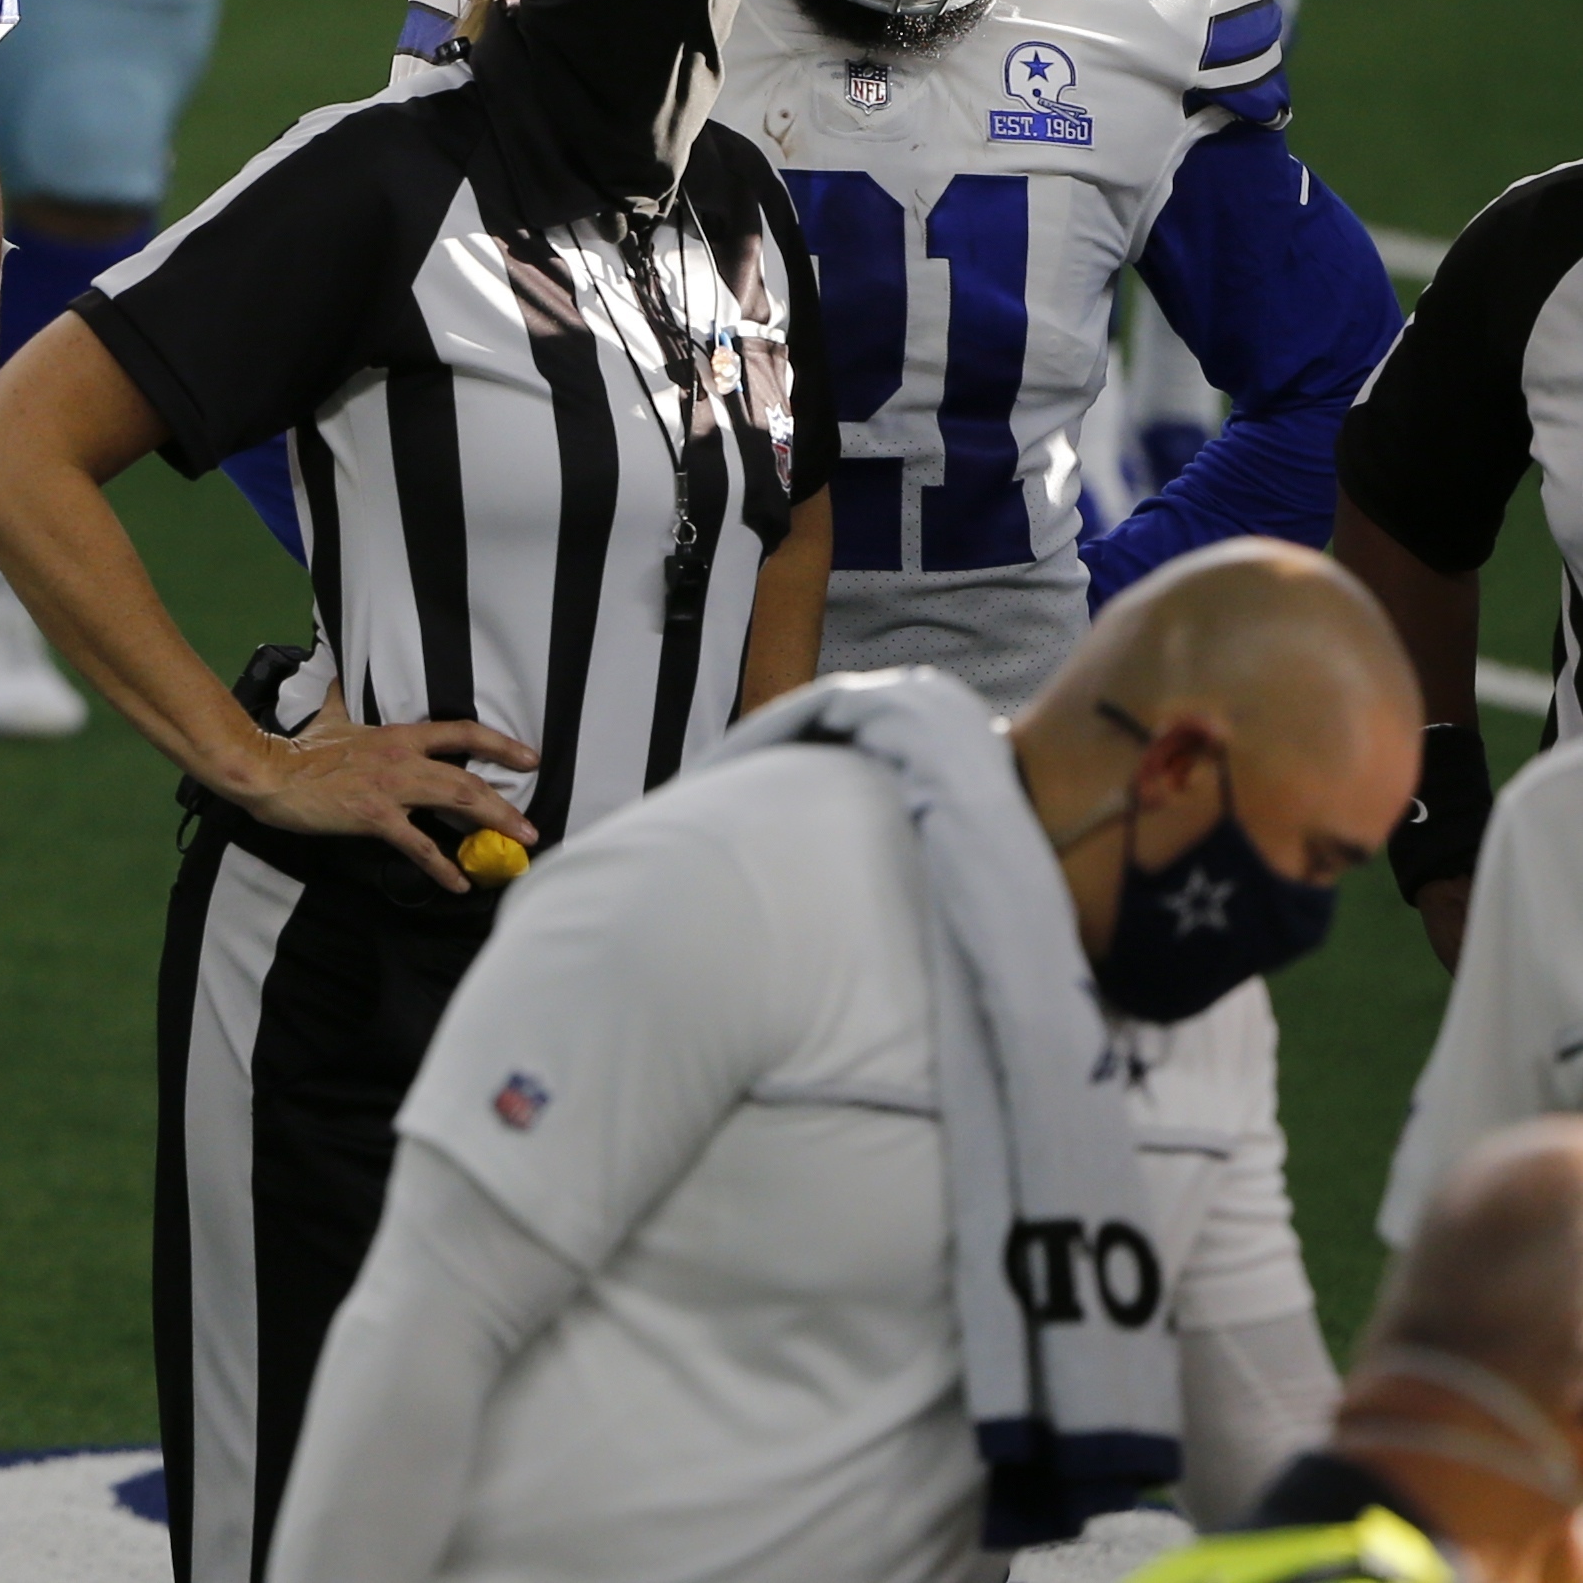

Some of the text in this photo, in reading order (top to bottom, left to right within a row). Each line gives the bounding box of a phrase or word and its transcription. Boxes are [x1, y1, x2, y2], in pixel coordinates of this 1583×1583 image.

[852, 78, 885, 102] NFL
[993, 115, 1089, 141] EST. 1960
[779, 170, 1038, 571] 21
